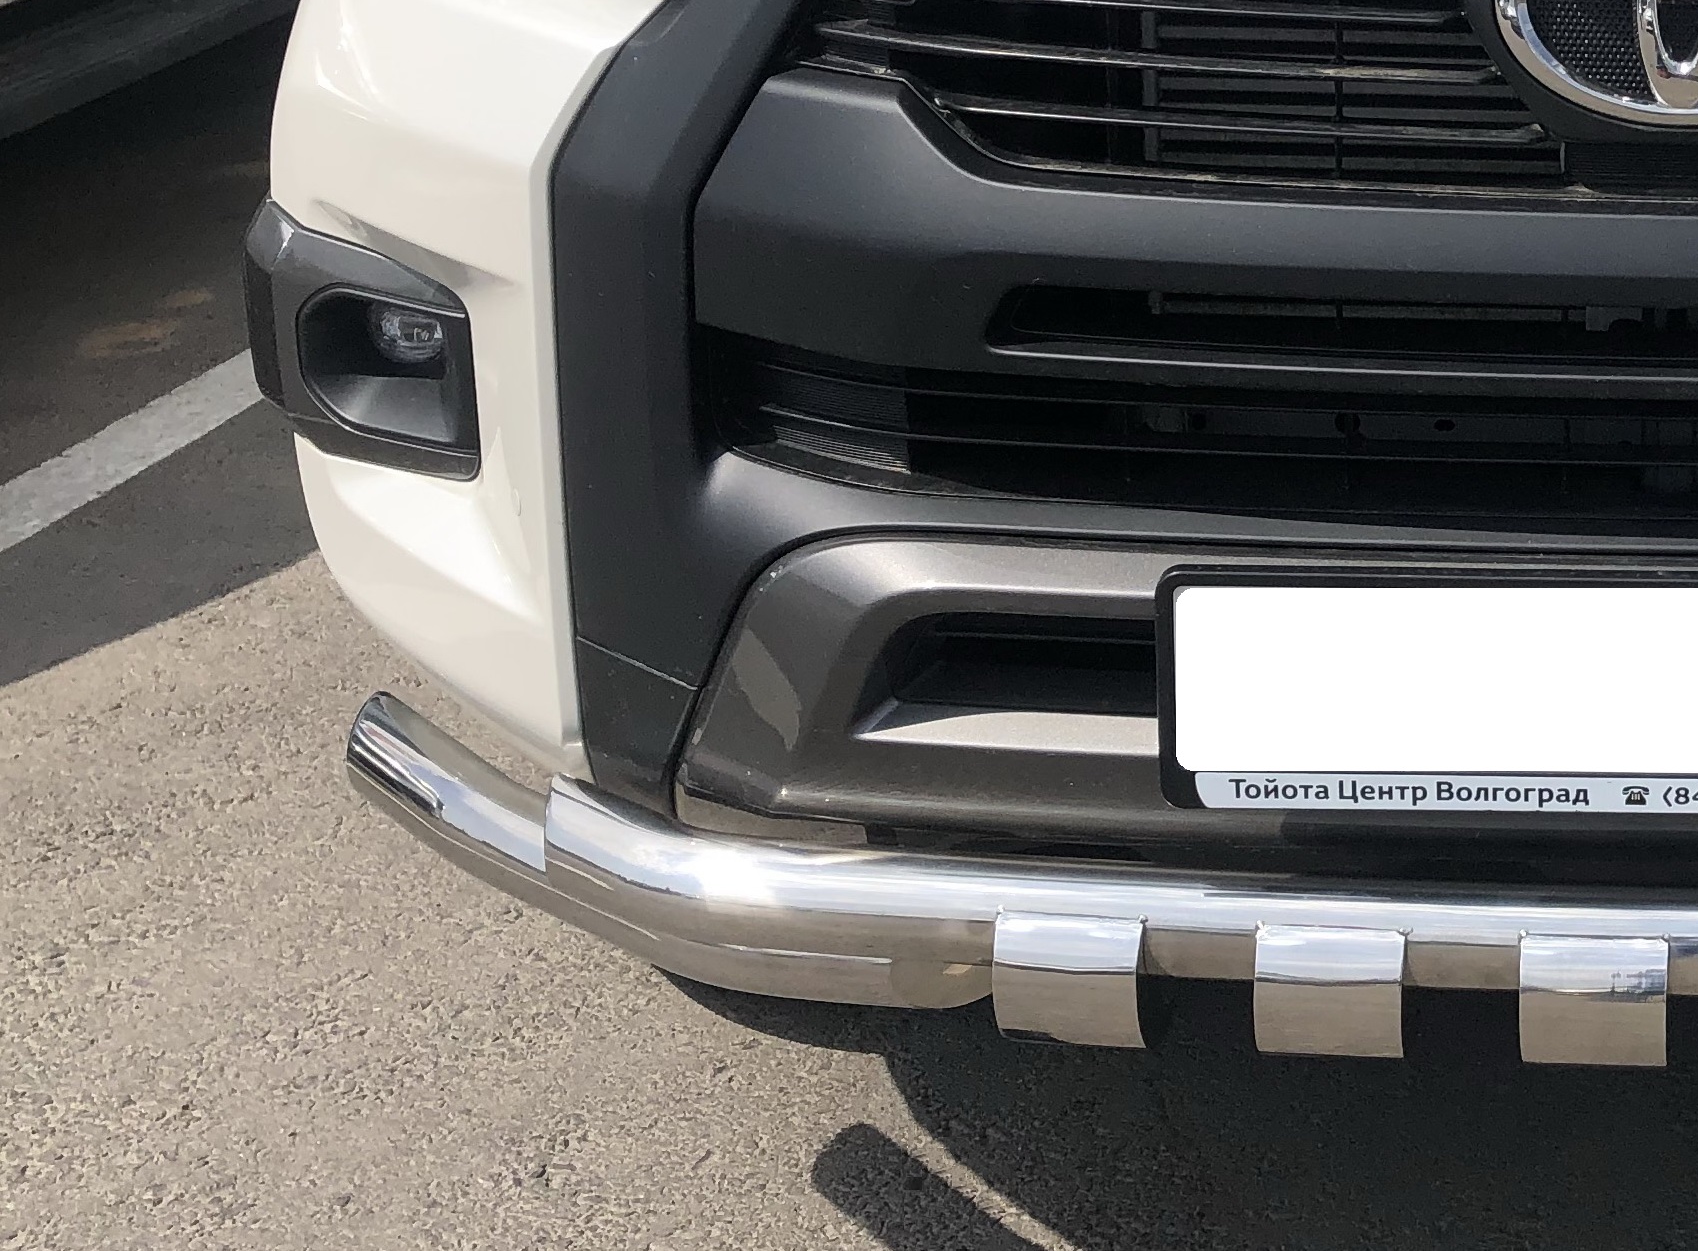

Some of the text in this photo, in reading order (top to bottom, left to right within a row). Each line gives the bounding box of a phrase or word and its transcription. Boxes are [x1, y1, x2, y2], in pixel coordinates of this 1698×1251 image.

[1228, 777, 1330, 801] Тойота
[1338, 781, 1428, 806] Центр
[1435, 781, 1591, 808] Волгоград
